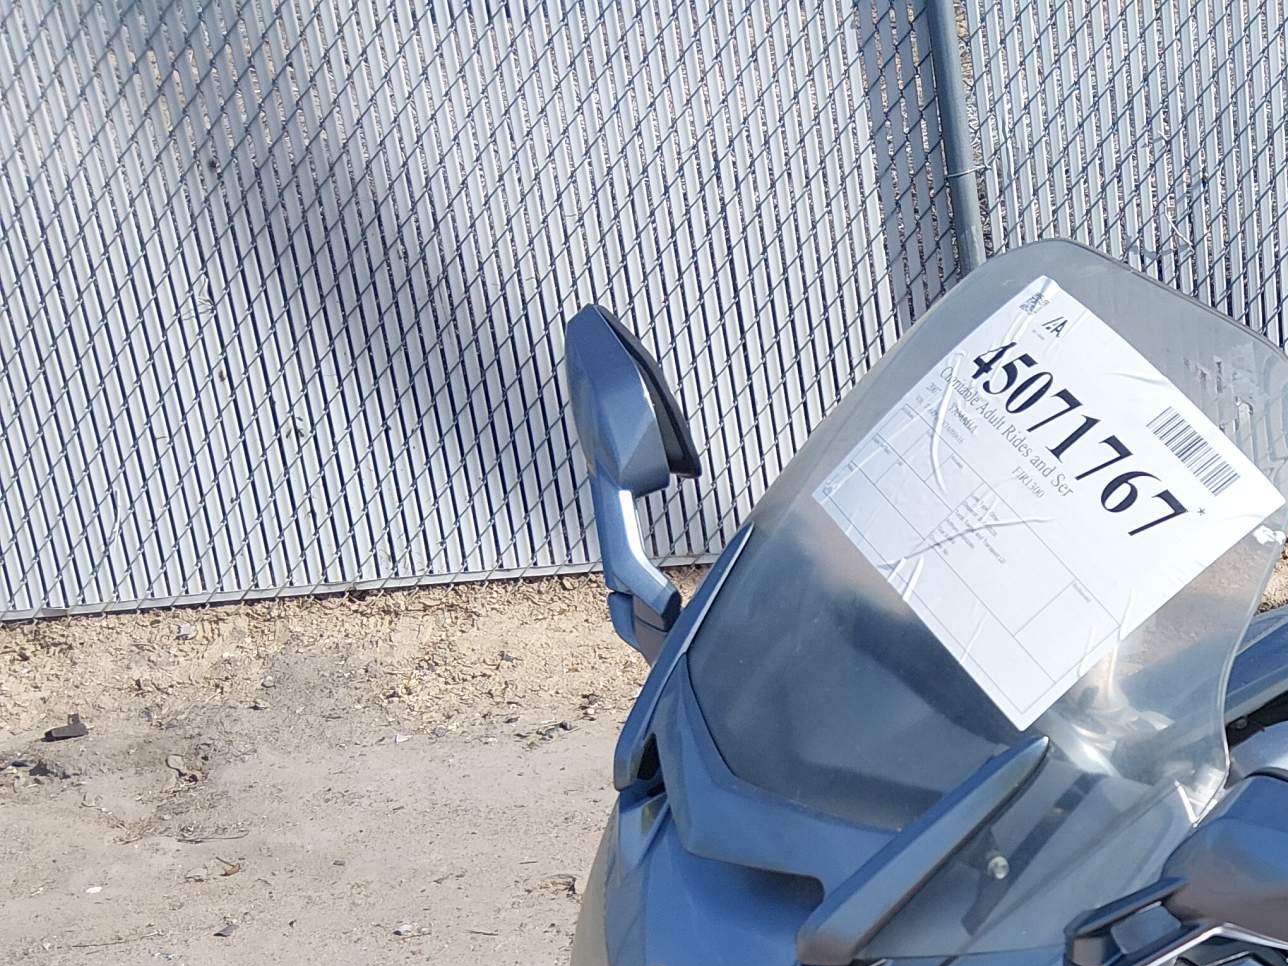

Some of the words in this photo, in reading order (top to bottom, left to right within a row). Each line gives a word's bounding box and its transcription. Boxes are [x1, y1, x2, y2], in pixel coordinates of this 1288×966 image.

[971, 342, 1190, 537] 45071767
[976, 400, 1007, 431] Adult
[1001, 424, 1033, 458] Rides
[1029, 454, 1057, 478] and
[1050, 473, 1074, 497] Ser
